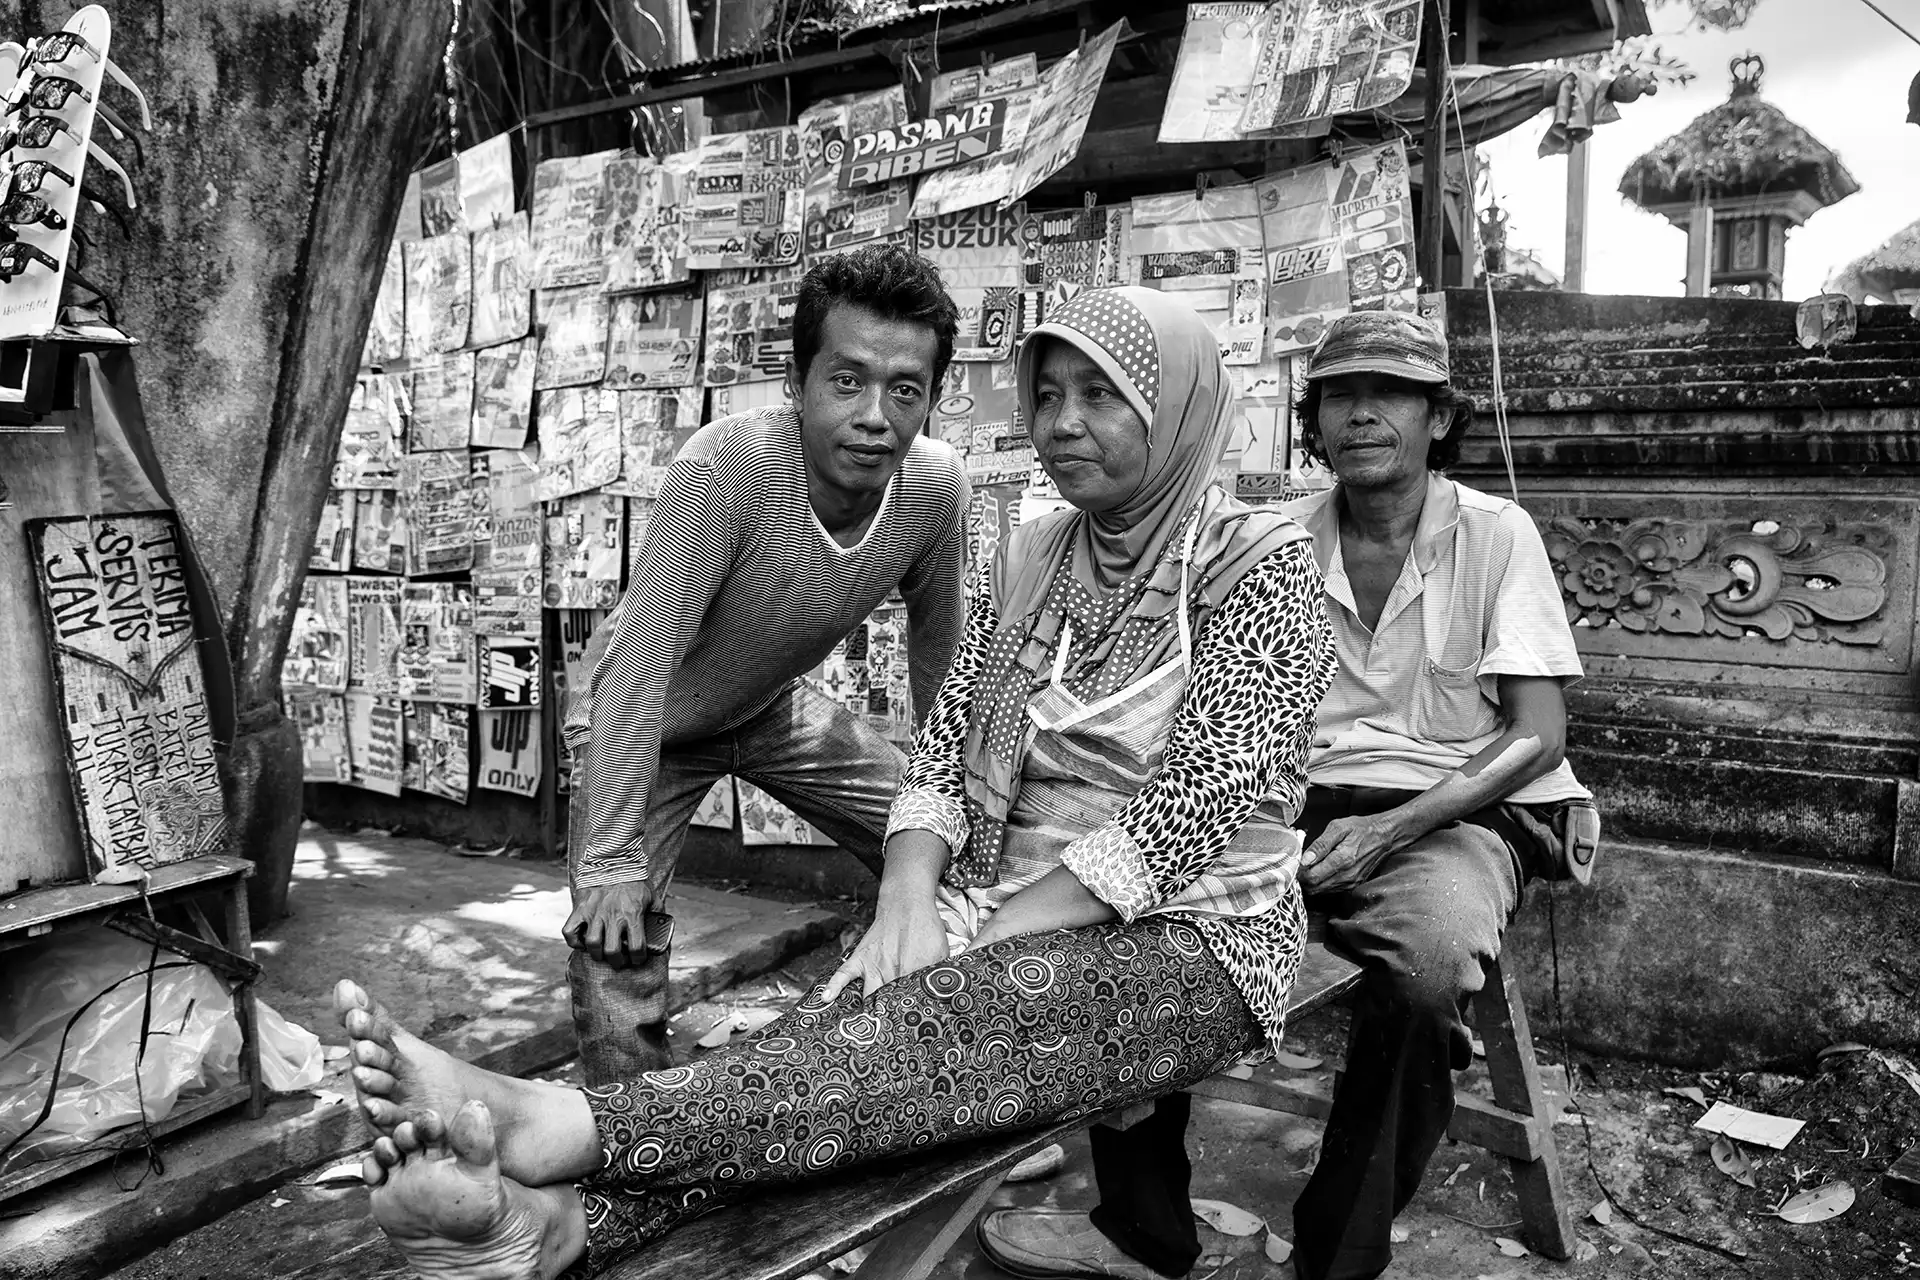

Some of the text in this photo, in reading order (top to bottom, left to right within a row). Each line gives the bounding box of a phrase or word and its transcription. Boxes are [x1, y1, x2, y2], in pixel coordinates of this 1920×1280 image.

[849, 131, 991, 188] RIBEN
[852, 101, 995, 162] PASANG
[919, 205, 1024, 229] SUZUK
[919, 227, 1018, 249] SUZUK
[941, 268, 1018, 287] ONDA
[46, 546, 106, 639] JAM
[95, 533, 152, 643] SERVIS
[137, 525, 193, 638] TERIMA
[487, 650, 530, 704] JIP
[529, 649, 540, 706] ONLY
[90, 706, 134, 800] TUKAR
[491, 711, 531, 770] JIP
[190, 747, 220, 793] JAM
[488, 769, 536, 791] ONLY
